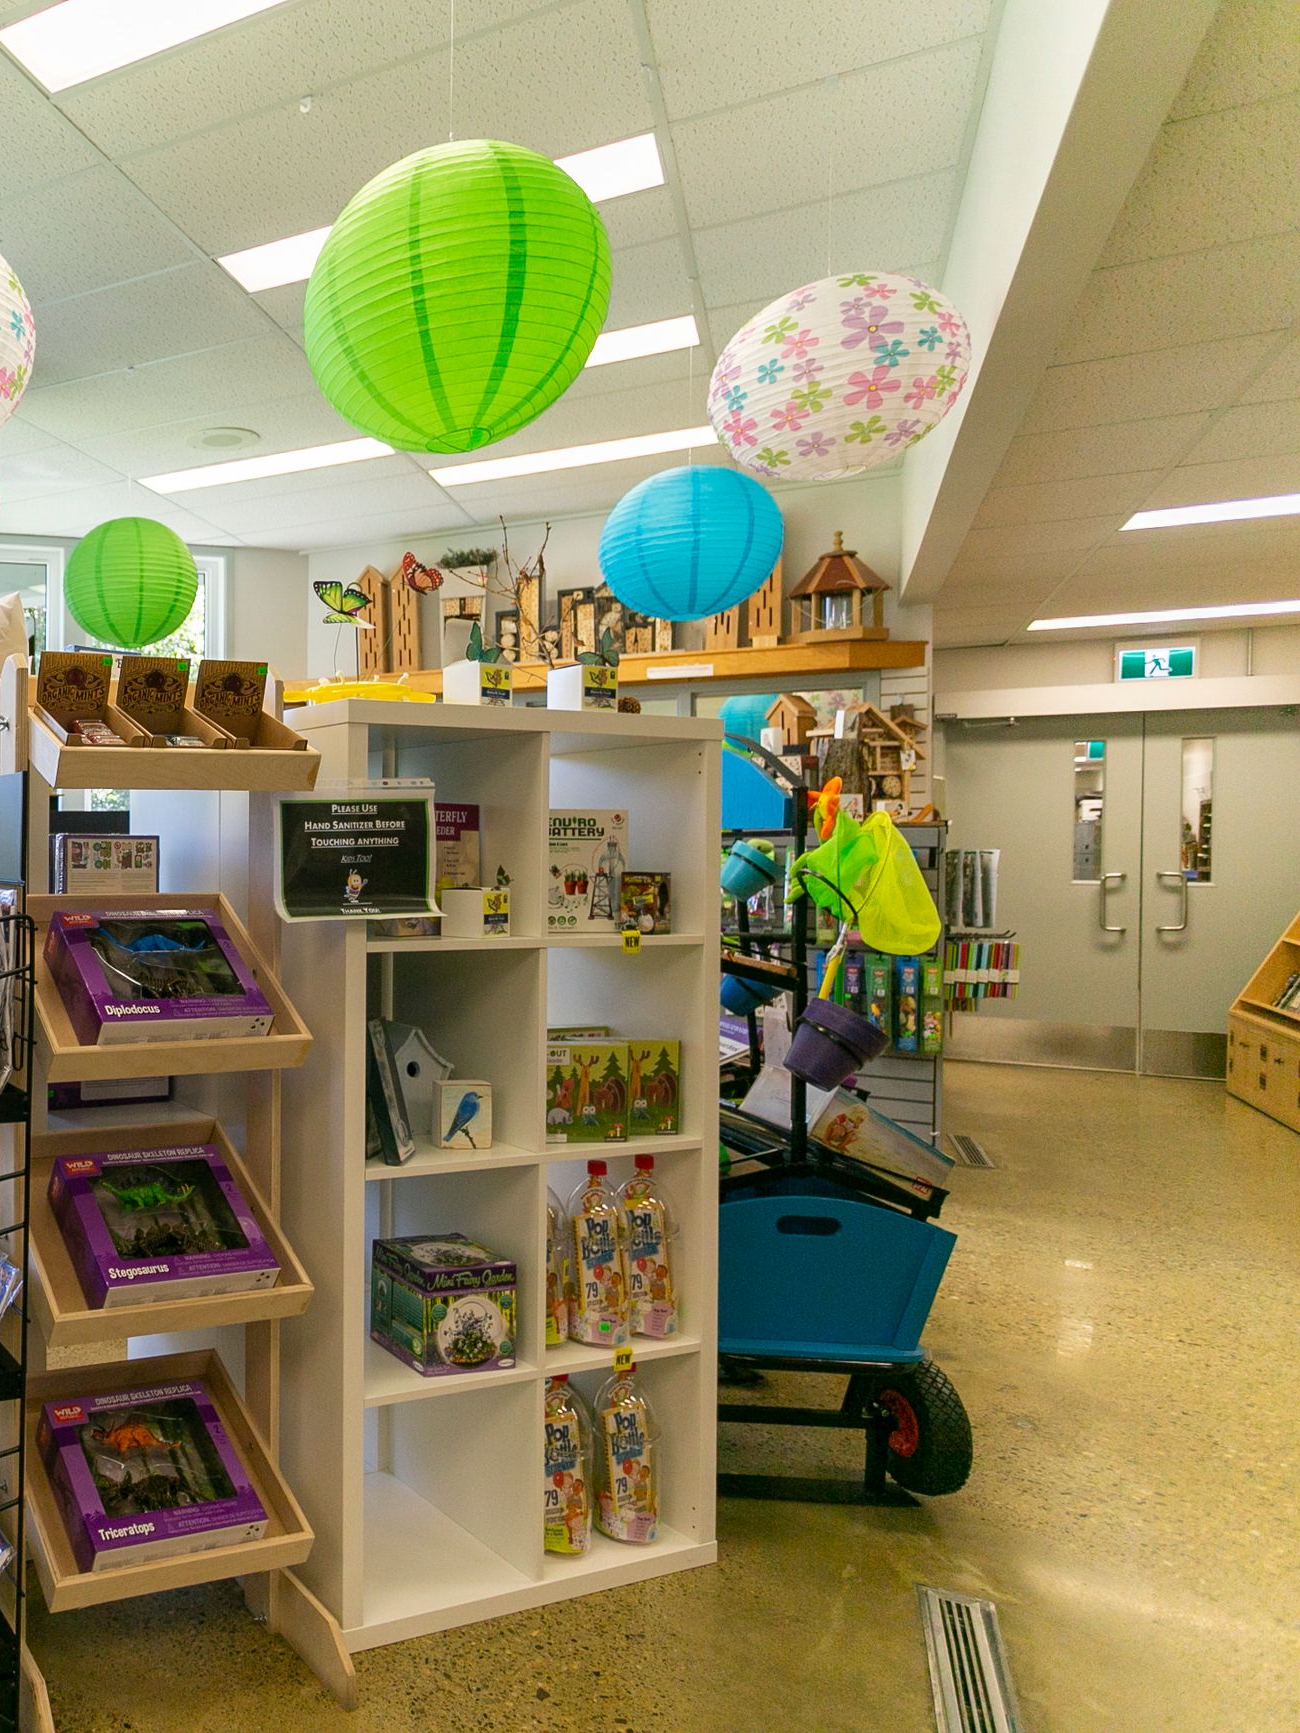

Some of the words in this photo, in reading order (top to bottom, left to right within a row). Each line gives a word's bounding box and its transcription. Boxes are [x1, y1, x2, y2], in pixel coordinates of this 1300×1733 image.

[331, 804, 360, 814] PLEASE
[361, 804, 378, 813] USE
[435, 810, 468, 823] TERFLY
[304, 821, 331, 830] HAND
[332, 820, 374, 830] SANITIZER
[375, 820, 405, 830] BEFORE
[436, 826, 455, 836] EDER
[63, 914, 92, 922] WILD
[625, 935, 640, 948] NEW
[104, 1004, 161, 1017] Diplodocus
[107, 1151, 142, 1161] DINOSAUR
[143, 1149, 176, 1159] SKELETON
[176, 1147, 205, 1156] REPLICA
[66, 1160, 93, 1169] WILD
[585, 1217, 608, 1238] Pop
[625, 1209, 652, 1230] Pop
[581, 1234, 616, 1260] Bottle
[108, 1264, 170, 1280] Stegosaurus
[452, 1271, 481, 1288] Fairy
[482, 1268, 515, 1288] Garden
[586, 1281, 599, 1299] 79
[631, 1273, 643, 1291] 79
[616, 1353, 631, 1366] NEW
[95, 1395, 130, 1406] DINOSAUR
[130, 1389, 164, 1400] SKELETON
[164, 1385, 192, 1395] REPLICA
[54, 1406, 82, 1417] WILD
[613, 1412, 636, 1433] Pop
[545, 1423, 569, 1445] Pop
[611, 1427, 645, 1456] Bottle
[616, 1477, 628, 1494] 79
[544, 1489, 559, 1507] 79
[98, 1522, 155, 1541] Triceratops
